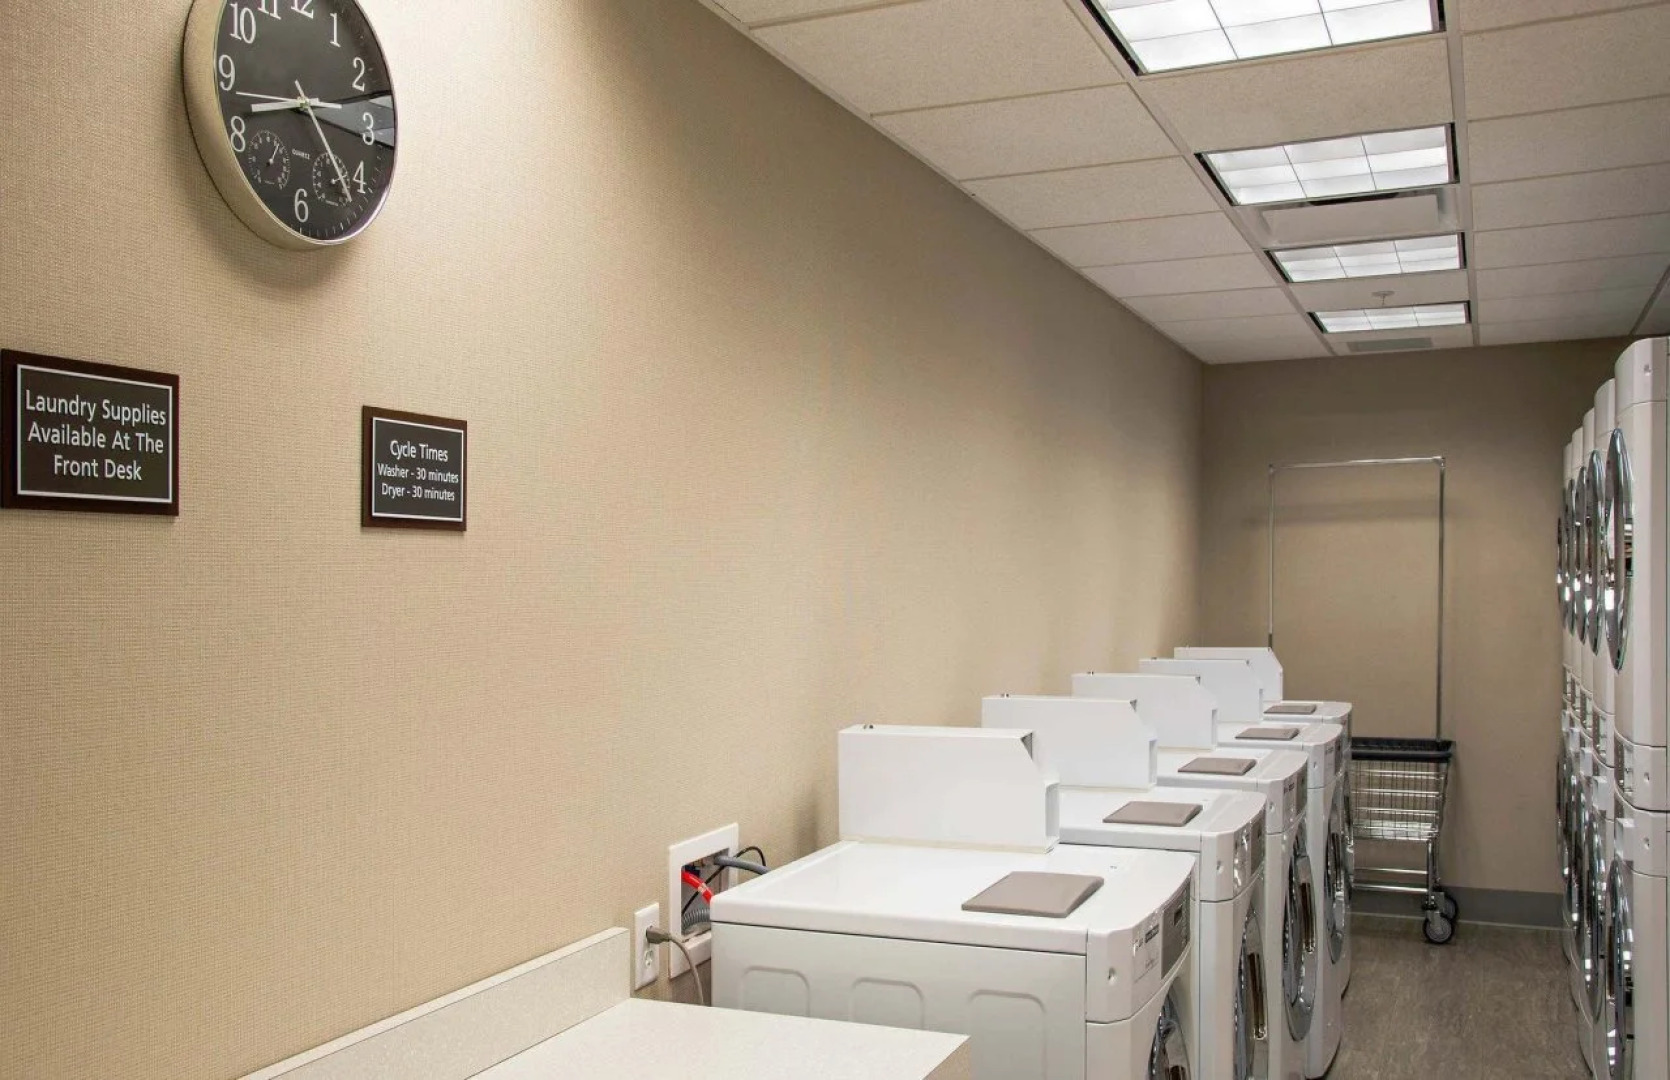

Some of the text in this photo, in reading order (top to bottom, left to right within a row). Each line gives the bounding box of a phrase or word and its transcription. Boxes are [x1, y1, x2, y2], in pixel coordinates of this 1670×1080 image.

[229, 2, 257, 44] 10
[330, 12, 341, 48] 1
[218, 54, 236, 91] 9
[351, 56, 366, 92] 2
[230, 115, 246, 152] 8
[361, 112, 375, 146] 3
[352, 160, 367, 194] 4
[294, 188, 309, 223] 6
[25, 389, 167, 427] Laundry Supplies
[27, 421, 164, 454] Available At The
[389, 440, 449, 462] Cycle Times
[54, 454, 143, 481] Front Desk
[377, 462, 410, 479] Washer
[416, 467, 427, 480] 30
[428, 469, 459, 484] minutes
[381, 482, 405, 499] Dryer
[412, 485, 423, 498] 30
[424, 487, 455, 502] minutes
